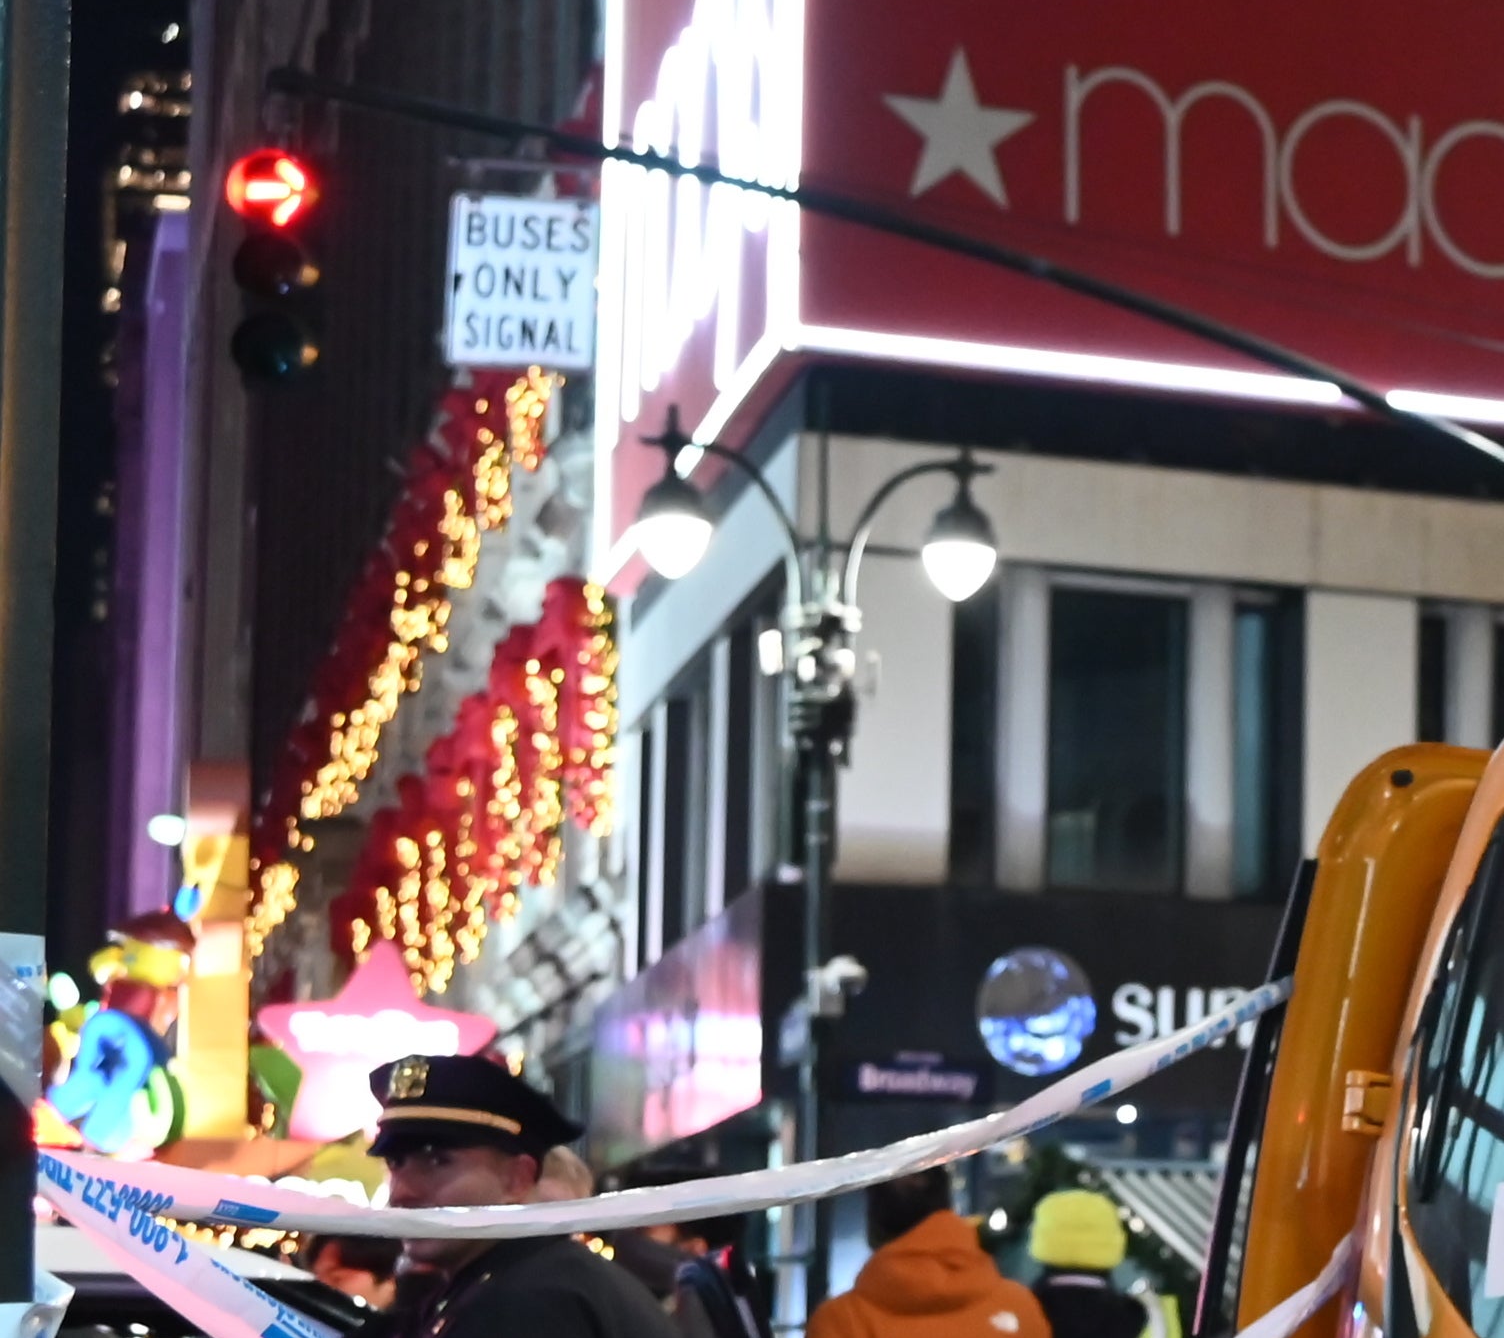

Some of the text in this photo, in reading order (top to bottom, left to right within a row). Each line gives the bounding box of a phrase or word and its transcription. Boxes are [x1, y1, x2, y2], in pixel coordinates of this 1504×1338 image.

[467, 212, 590, 253] BUSES
[474, 263, 581, 301] ONLY
[463, 312, 582, 354] SIGNAL
